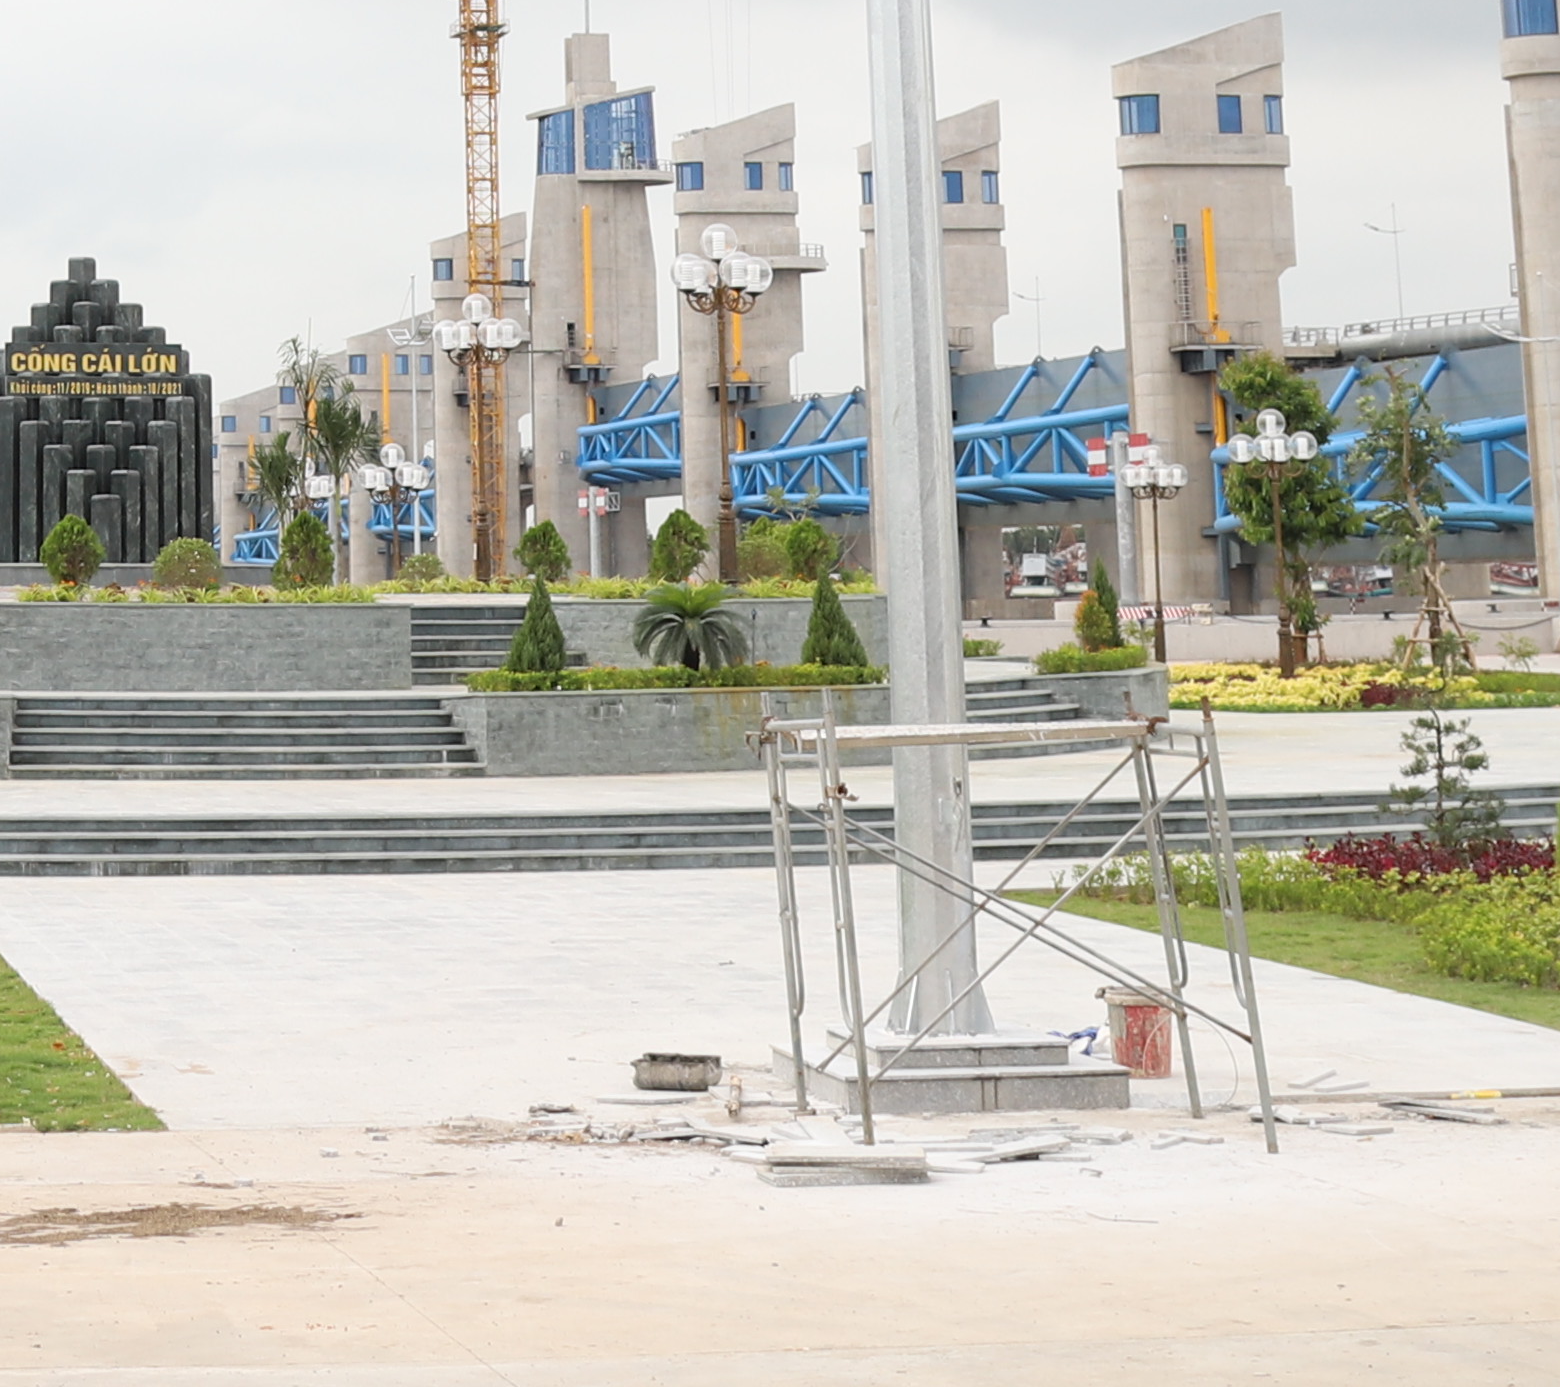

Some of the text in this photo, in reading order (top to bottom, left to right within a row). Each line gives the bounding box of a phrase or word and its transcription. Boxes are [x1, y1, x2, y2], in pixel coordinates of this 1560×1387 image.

[10, 344, 177, 373] CỐNG CÁI LỚN
